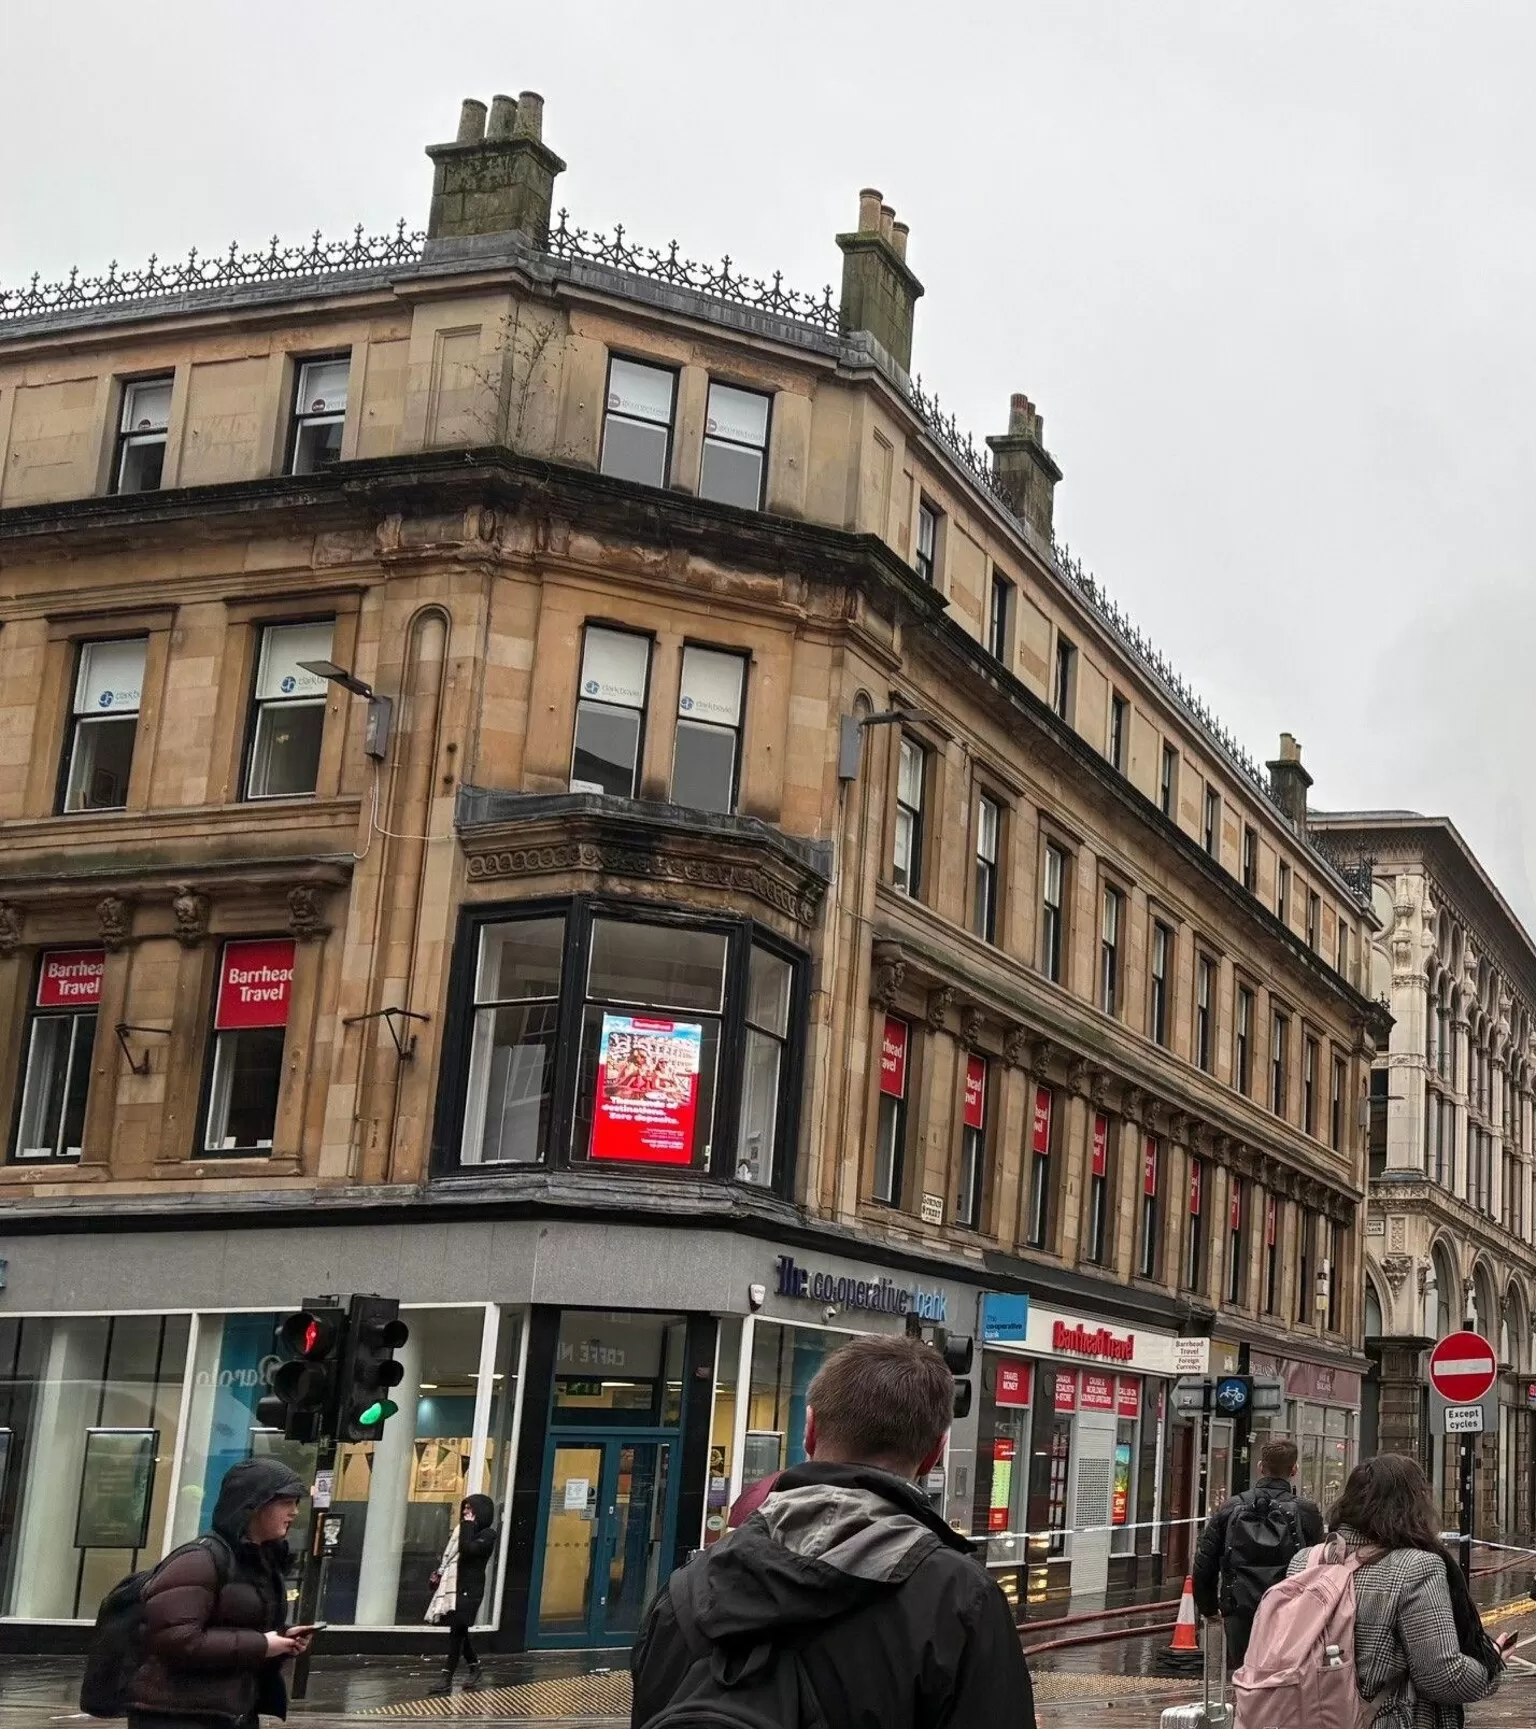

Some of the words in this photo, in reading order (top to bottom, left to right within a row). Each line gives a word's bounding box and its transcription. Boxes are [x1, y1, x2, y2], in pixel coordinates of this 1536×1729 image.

[48, 961, 104, 977] Barrhea
[58, 979, 99, 995] Travel
[239, 985, 284, 1002] Travel
[911, 1283, 947, 1321] bank
[1103, 1331, 1135, 1361] Travel
[1449, 1410, 1479, 1420] Except
[1450, 1420, 1478, 1429] cycles
